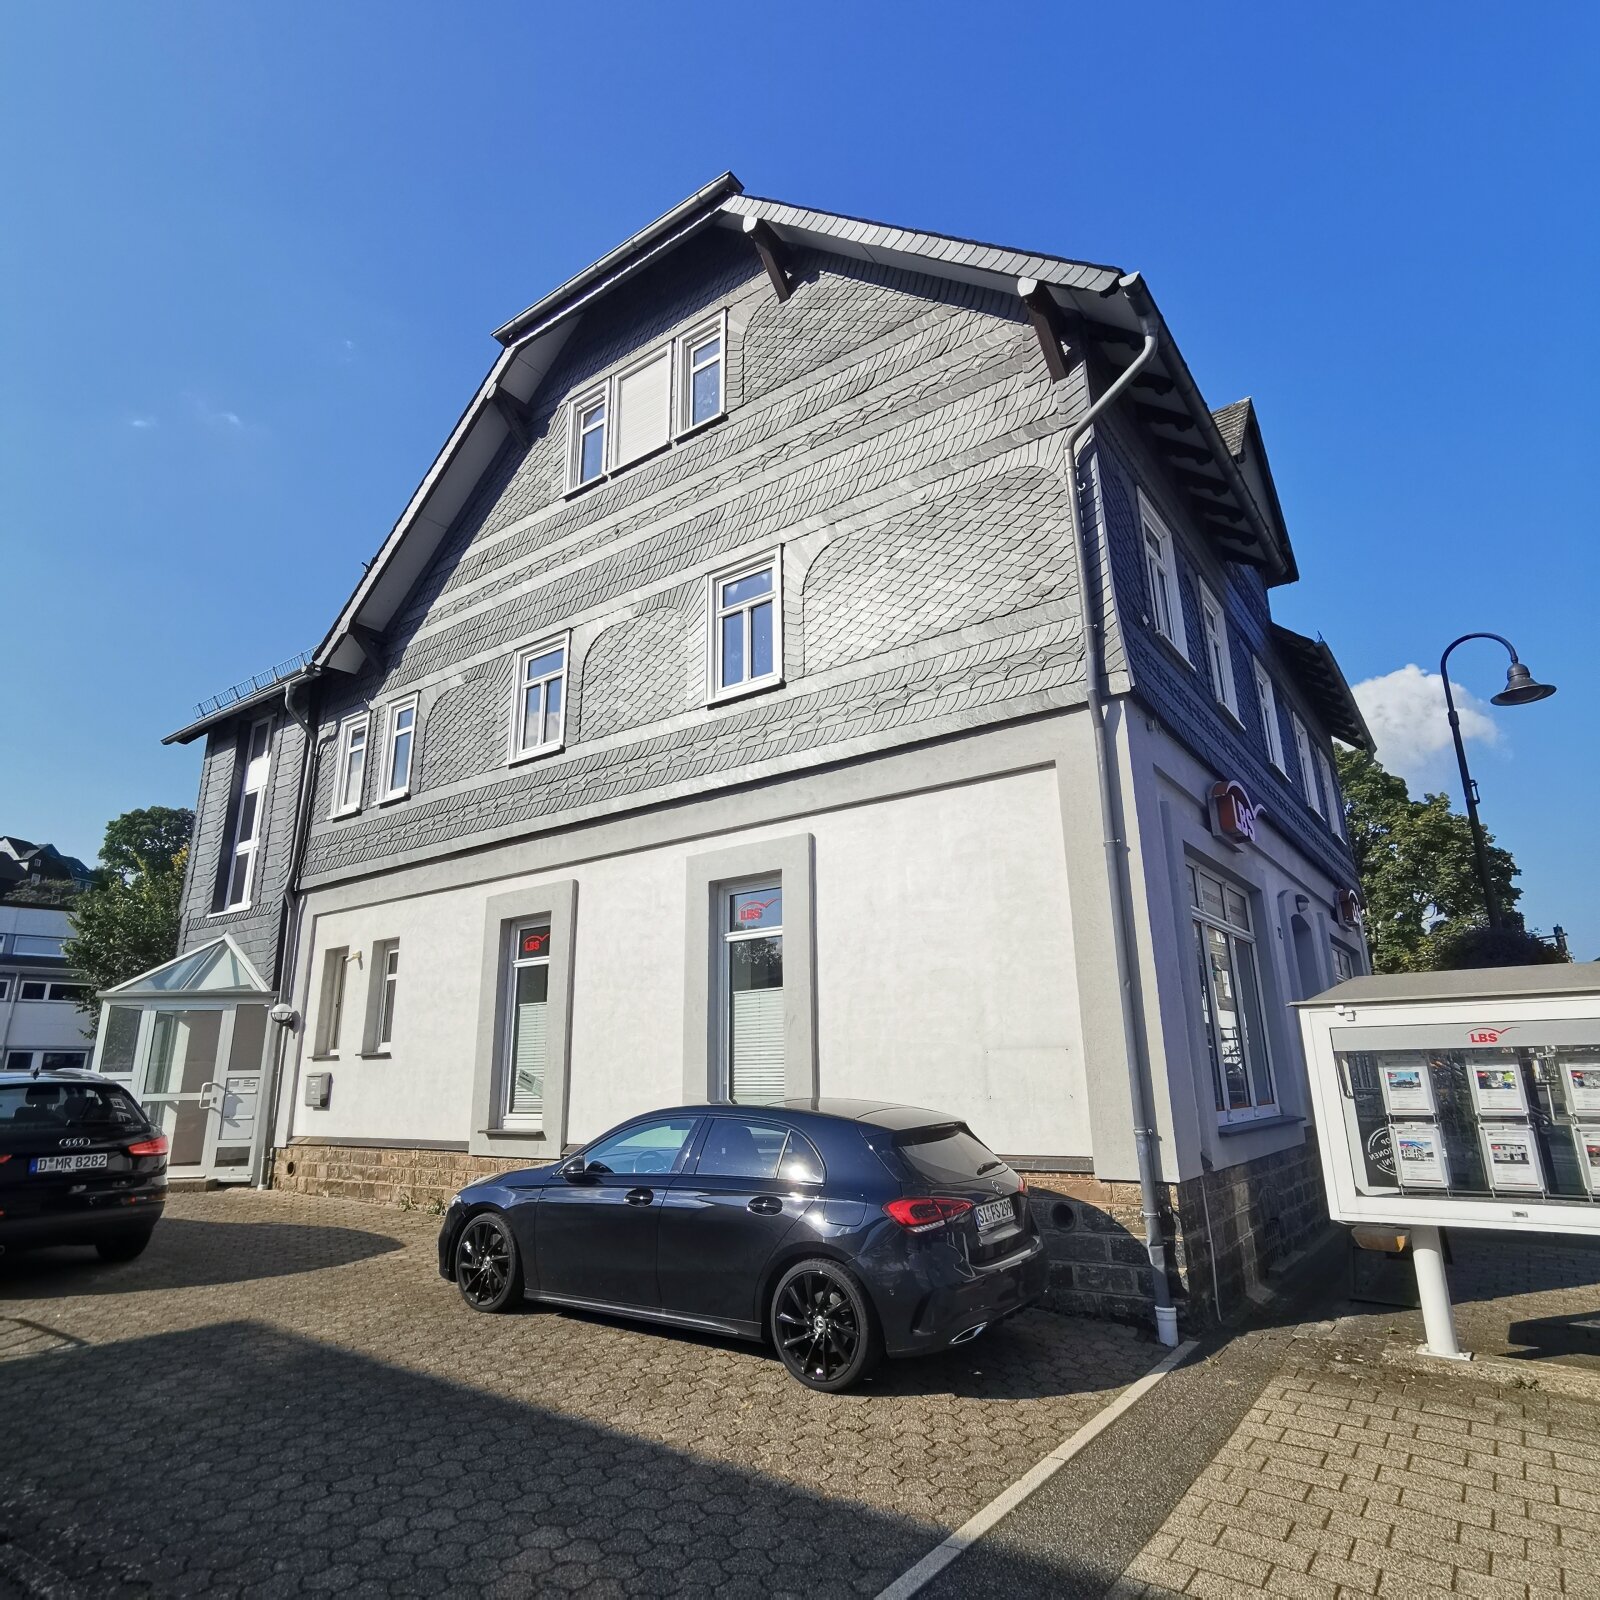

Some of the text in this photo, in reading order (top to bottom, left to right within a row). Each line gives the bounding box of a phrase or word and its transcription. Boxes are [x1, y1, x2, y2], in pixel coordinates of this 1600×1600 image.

[1231, 794, 1256, 842] LBS
[740, 908, 762, 921] LBS
[524, 941, 540, 952] LBS
[1470, 1033, 1498, 1043] LBS
[39, 1155, 106, 1170] D MR 8282
[978, 1207, 989, 1224] SI
[990, 1203, 1001, 1220] FS
